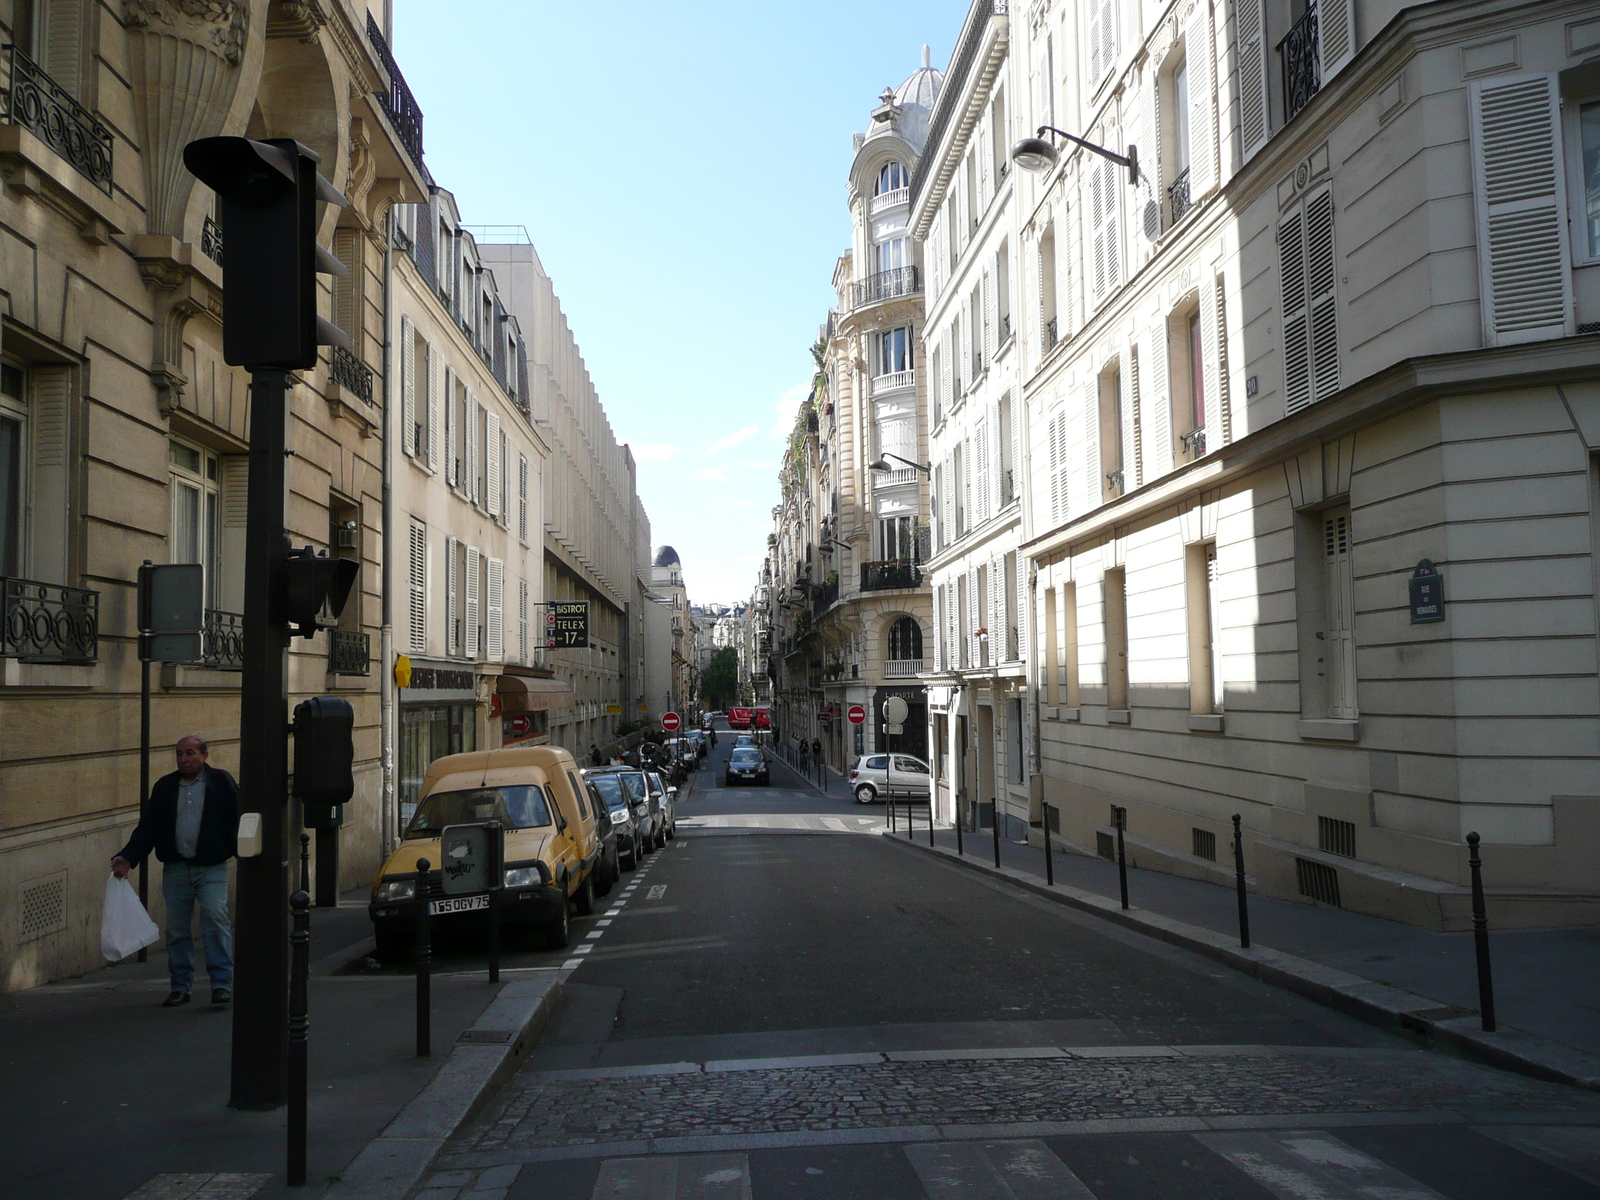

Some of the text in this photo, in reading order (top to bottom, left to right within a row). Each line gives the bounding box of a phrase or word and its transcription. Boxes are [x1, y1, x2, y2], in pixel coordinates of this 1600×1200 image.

[1421, 585, 1430, 593] RUE
[556, 604, 586, 614] BISTROT
[1416, 604, 1438, 614] RENAUDES
[556, 620, 585, 630] TELEX
[564, 631, 578, 645] 17
[475, 895, 490, 908] 75
